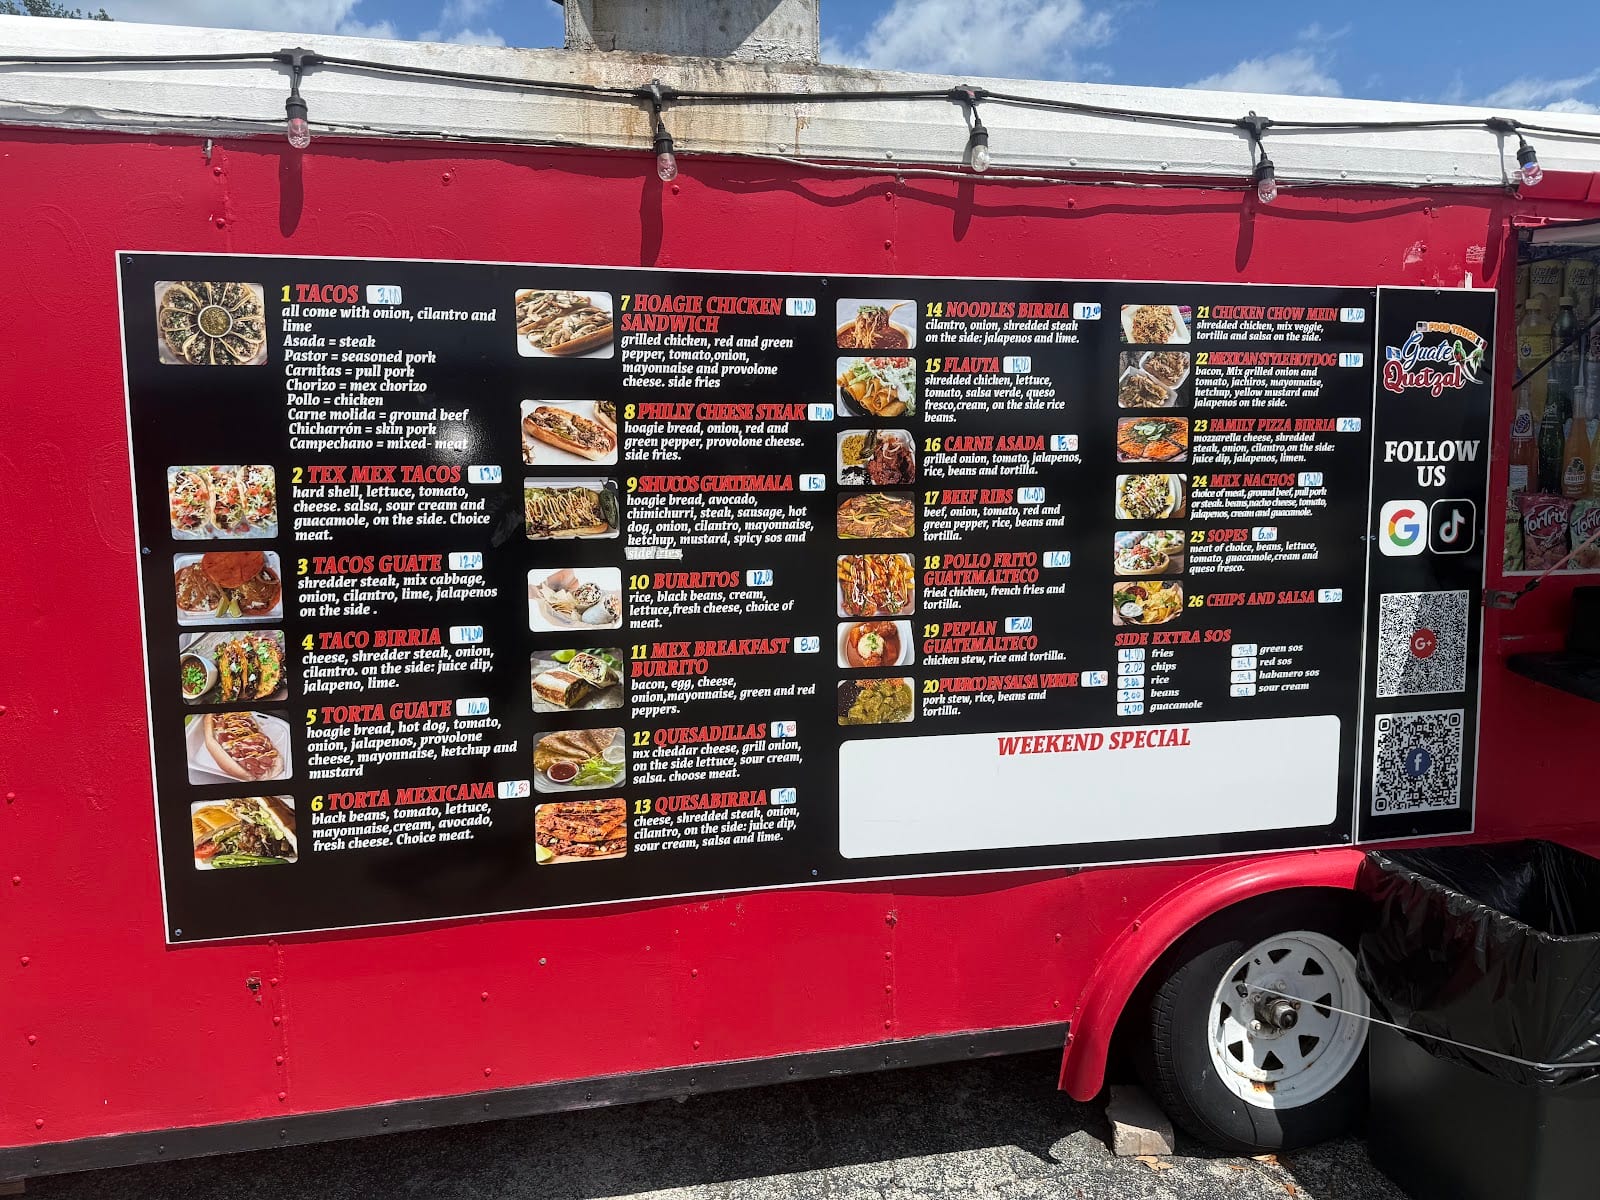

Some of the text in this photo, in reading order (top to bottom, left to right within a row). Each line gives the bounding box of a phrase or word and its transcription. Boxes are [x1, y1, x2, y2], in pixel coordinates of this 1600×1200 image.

[281, 284, 359, 303] 1 TACOS
[621, 294, 783, 315] 7 HOAGIE CHICKEN
[926, 302, 1069, 318] 14 NOODLES BIRRIA
[282, 305, 496, 322] all come with onion, cilantro and
[1197, 306, 1338, 321] 21 CHICKEN CHOW MEIN
[283, 320, 312, 332] lime
[621, 314, 720, 333] SANDWICH
[1428, 322, 1477, 342] FOOD TRUCK
[1402, 332, 1453, 371] Guate
[925, 357, 999, 373] 15 FLAUTA
[1196, 367, 1224, 377] bacon,
[1244, 368, 1273, 378] grilled
[1275, 368, 1299, 376] onion
[1301, 368, 1317, 376] and
[1383, 360, 1466, 397] Quetzal
[624, 403, 807, 420] 8 PHILLY CHEESE STEAK
[925, 413, 956, 422] beans.
[289, 423, 361, 435] Chicharrón
[376, 423, 403, 435] skin
[406, 424, 437, 437] pork
[1194, 419, 1335, 432] 23 FAMILY PIZZA BIRRIA
[924, 436, 1045, 452] 16 CARNE ASADA
[1384, 440, 1480, 462] FOLLOW
[625, 449, 681, 460] side fries.
[292, 465, 461, 483] 2 TEX MEX TACOS
[1192, 474, 1295, 487] 24 MEX NACHOS
[1417, 466, 1445, 487] US
[627, 475, 793, 493] 9 SHUCOS GUATEMALA
[924, 489, 1013, 505] 17 BEEF RIBS
[628, 532, 806, 548] ketchup, mustard, spicy sos and
[924, 530, 962, 541] tortilla.
[1190, 529, 1248, 542] 25 SOPES
[297, 555, 442, 574] 3 TACOS GUATE
[924, 552, 1037, 569] 18 POLLO FRITO
[924, 568, 1039, 586] GUATEMALTECO
[1189, 563, 1244, 575] queso fresco.
[629, 571, 739, 589] 10 BURRITOS
[1188, 590, 1315, 607] 26 CHIPS AND SALSA
[630, 618, 662, 629] meat.
[923, 621, 997, 637] 19 PEPIAN
[302, 628, 441, 650] 4 TACO BIRRIA
[923, 635, 1038, 653] GUATEMALTECO
[1115, 629, 1231, 646] SIDE EXTRA SOS
[630, 638, 790, 659] 11 MEX BREAKFAST
[1152, 649, 1174, 658] fries
[1260, 644, 1303, 656] green sos
[923, 650, 1066, 665] chicken stew, rice and tortilla.
[1260, 657, 1292, 666] red sos
[631, 659, 708, 677] BURRITO
[1151, 662, 1177, 672] chips
[1260, 669, 1319, 679] habanero sos
[303, 678, 399, 695] jalapeno, lime.
[1151, 675, 1169, 685] rice
[1259, 682, 1309, 693] sour cream
[1150, 688, 1179, 698] beans
[306, 700, 452, 725] 5 TORTA GUATE
[1150, 701, 1203, 712] guacamole
[632, 724, 766, 746] 12 QUESADILLAS
[998, 729, 1191, 755] WEEKEND SPECIAL
[309, 765, 363, 779] mustard
[311, 782, 495, 811] 6 TORTA MEXICANA
[634, 790, 767, 815] 13 QUESABIRRIA
[313, 830, 474, 851] fresh cheese. Choice meat.
